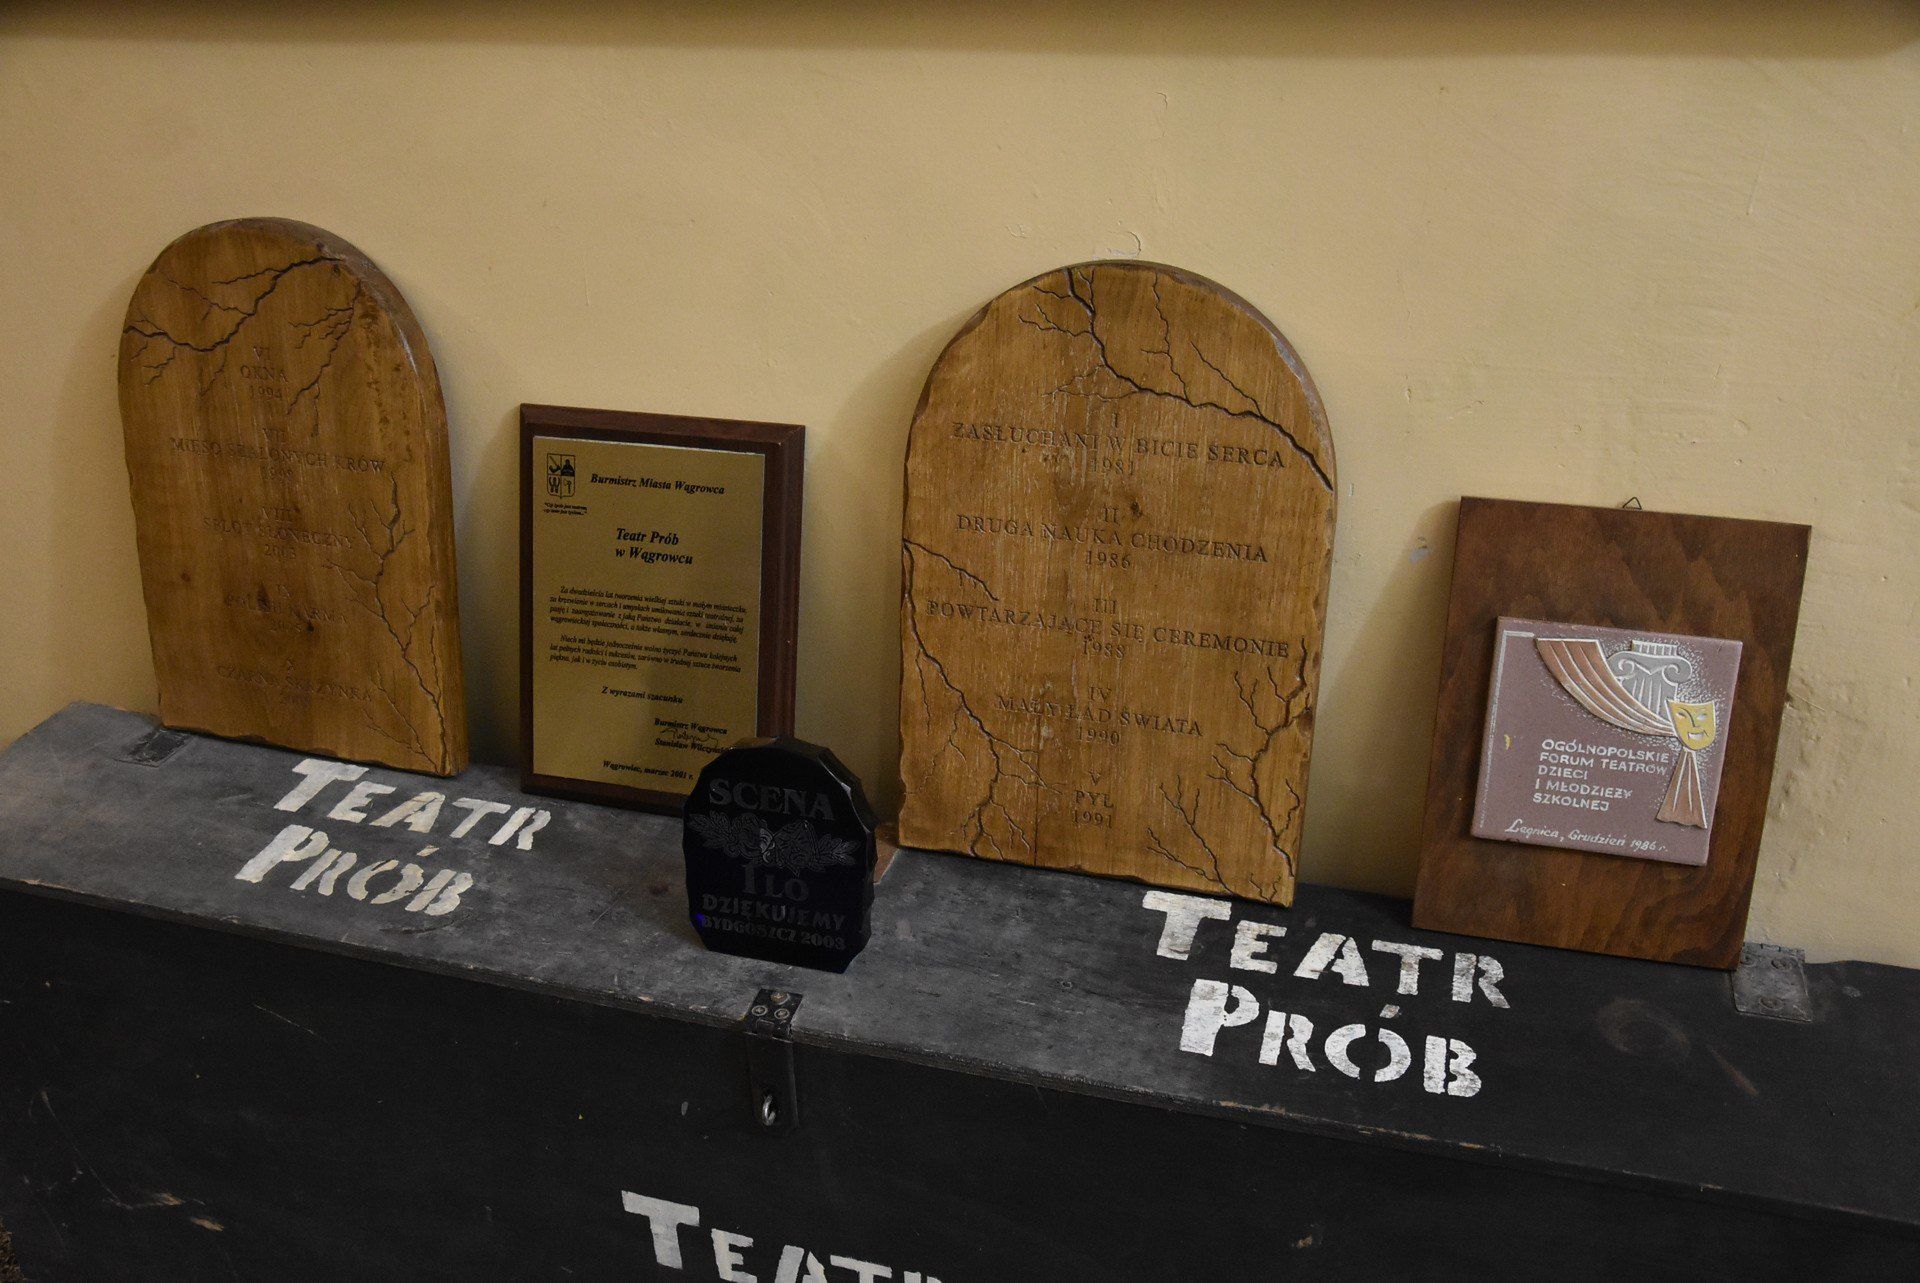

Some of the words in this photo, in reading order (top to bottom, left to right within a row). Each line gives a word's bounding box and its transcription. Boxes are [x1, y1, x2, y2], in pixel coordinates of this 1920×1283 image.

[240, 365, 289, 385] OKNA
[952, 421, 1099, 448] ZASŁUCHANI
[1106, 435, 1127, 451] W
[1136, 438, 1198, 459] BICIE
[1208, 445, 1286, 469] SERCA
[1091, 456, 1135, 476] 1981
[590, 473, 637, 489] Burmistrz
[640, 477, 671, 490] Miasta
[675, 480, 725, 496] Wągrowca
[1102, 507, 1119, 525] II
[617, 527, 646, 542] Teatr
[650, 530, 679, 546] Prób
[956, 514, 1035, 536] DRUGA
[1041, 523, 1123, 547] NAUKA
[1130, 532, 1269, 564] CHODZENIA
[615, 548, 625, 557] w
[630, 546, 693, 565] Wągrowcu
[1086, 549, 1131, 570] 1986
[1093, 598, 1117, 616] III
[927, 601, 1102, 634] POWTARZAJĄCE
[1110, 621, 1145, 643] SIĘ
[1152, 627, 1290, 659] CEREMONIE
[1082, 639, 1127, 659] 1988
[601, 686, 609, 694] Z
[609, 689, 646, 699] wyrazami
[647, 693, 684, 703] szacunku
[654, 717, 689, 729] Burmistrz
[690, 722, 728, 735] Wągrowca
[998, 696, 1061, 718] MAŁY
[1068, 705, 1112, 724] ŁAD
[1120, 706, 1204, 738] ŚWIATA
[655, 738, 688, 749] Stanisław
[1077, 726, 1120, 747] 1990
[1542, 738, 1670, 764] OGÓLNOPOLSKIE
[602, 760, 642, 773] Wągrowiec,
[671, 769, 688, 778] 2001
[1538, 765, 1588, 780] DZIECI
[1539, 752, 1594, 767] FORUM
[1601, 758, 1668, 776] TEATRÓW
[1088, 770, 1102, 788] V
[1535, 779, 1540, 790] I
[1546, 780, 1633, 798] MŁODZIEŻY
[273, 758, 551, 850] TEATR
[709, 778, 836, 821] SCENA
[1074, 791, 1115, 810] PYŁ
[1532, 792, 1610, 811] SZKOLNEJ
[1072, 810, 1115, 830] 1991
[1631, 839, 1657, 852] 1986
[234, 824, 474, 916] PRÓB
[702, 894, 846, 931] DZIĘKUJEMY
[800, 931, 846, 950] 2003
[1142, 890, 1511, 1009] TEATR
[1179, 978, 1482, 1098] PRÓB
[621, 1190, 943, 1283] TEAT
